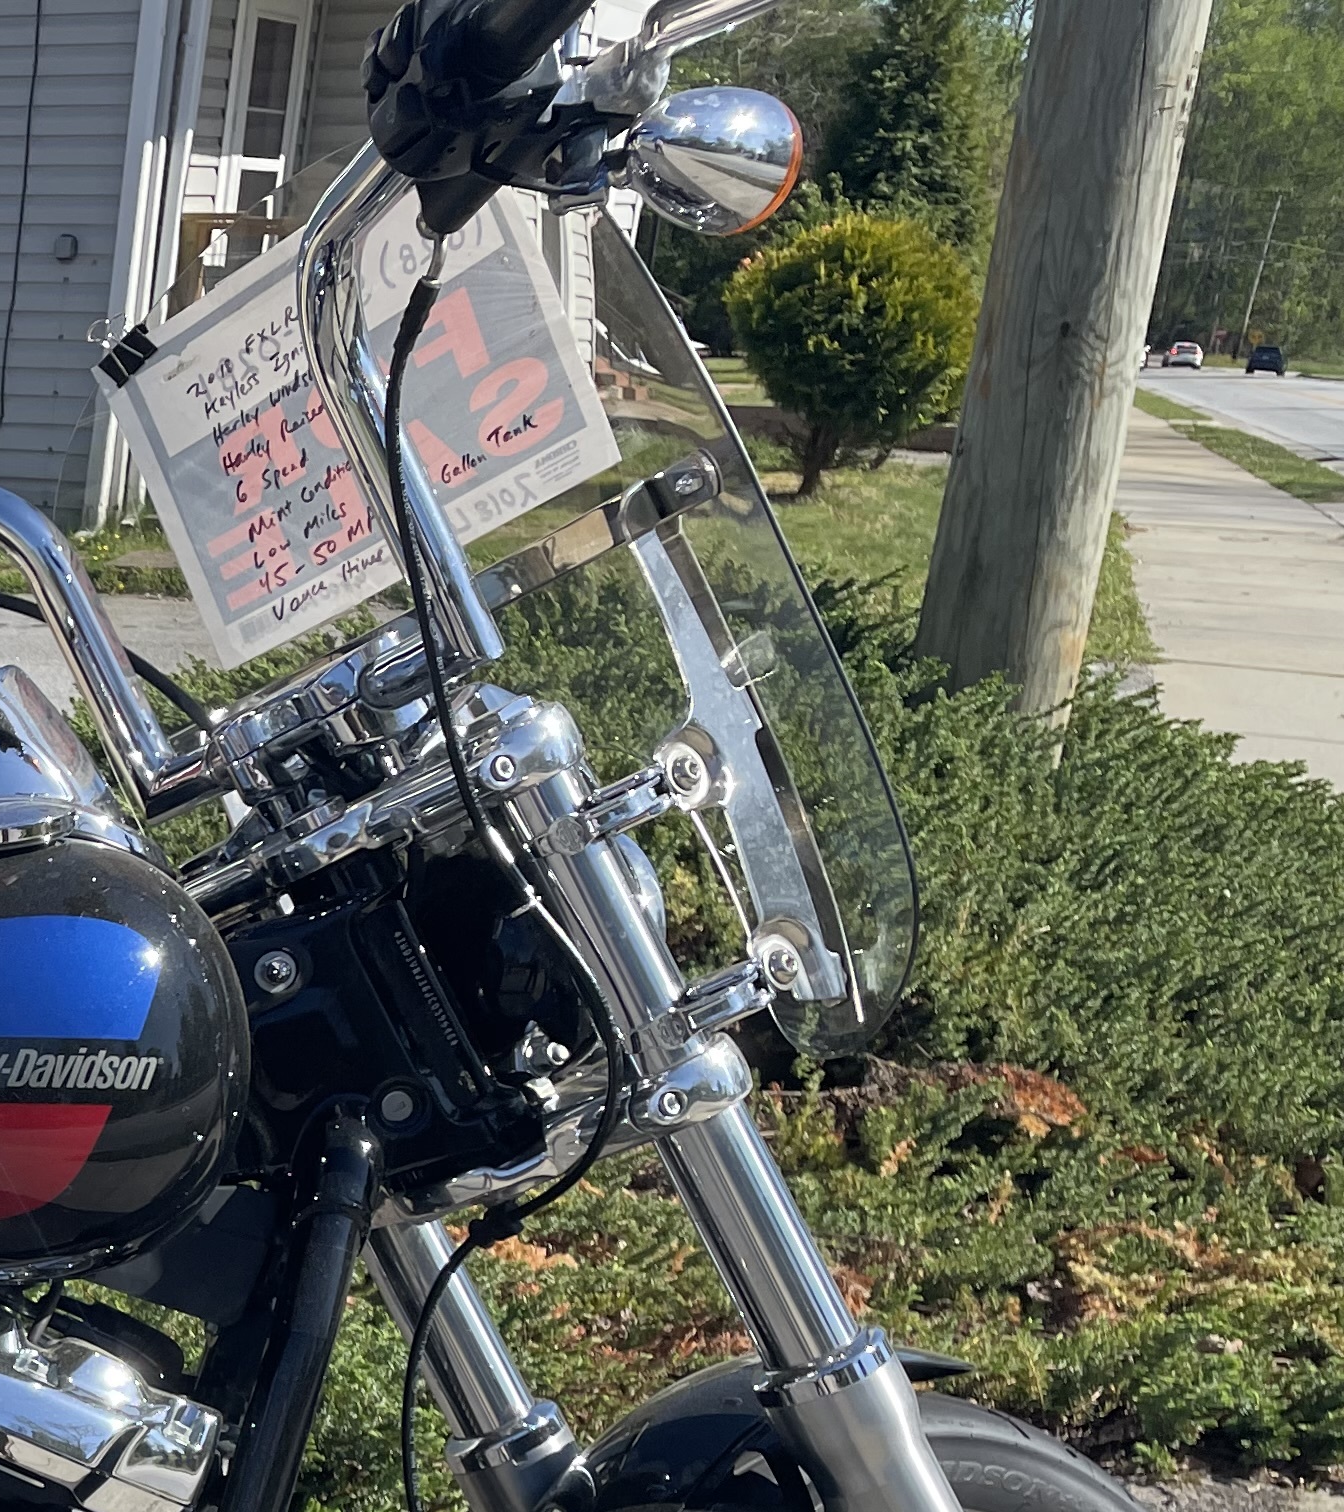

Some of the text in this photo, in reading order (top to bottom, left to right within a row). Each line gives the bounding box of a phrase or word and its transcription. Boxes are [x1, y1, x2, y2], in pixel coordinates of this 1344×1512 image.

[186, 358, 234, 398] 2018
[204, 342, 304, 420] Keyless Igni
[212, 407, 260, 448] Harley
[486, 414, 538, 448] Tank
[222, 439, 270, 477] Harley
[236, 448, 309, 503] 6 Speed
[248, 499, 293, 543] Mint
[253, 502, 347, 569] Low Miles
[272, 580, 328, 621] Vance
